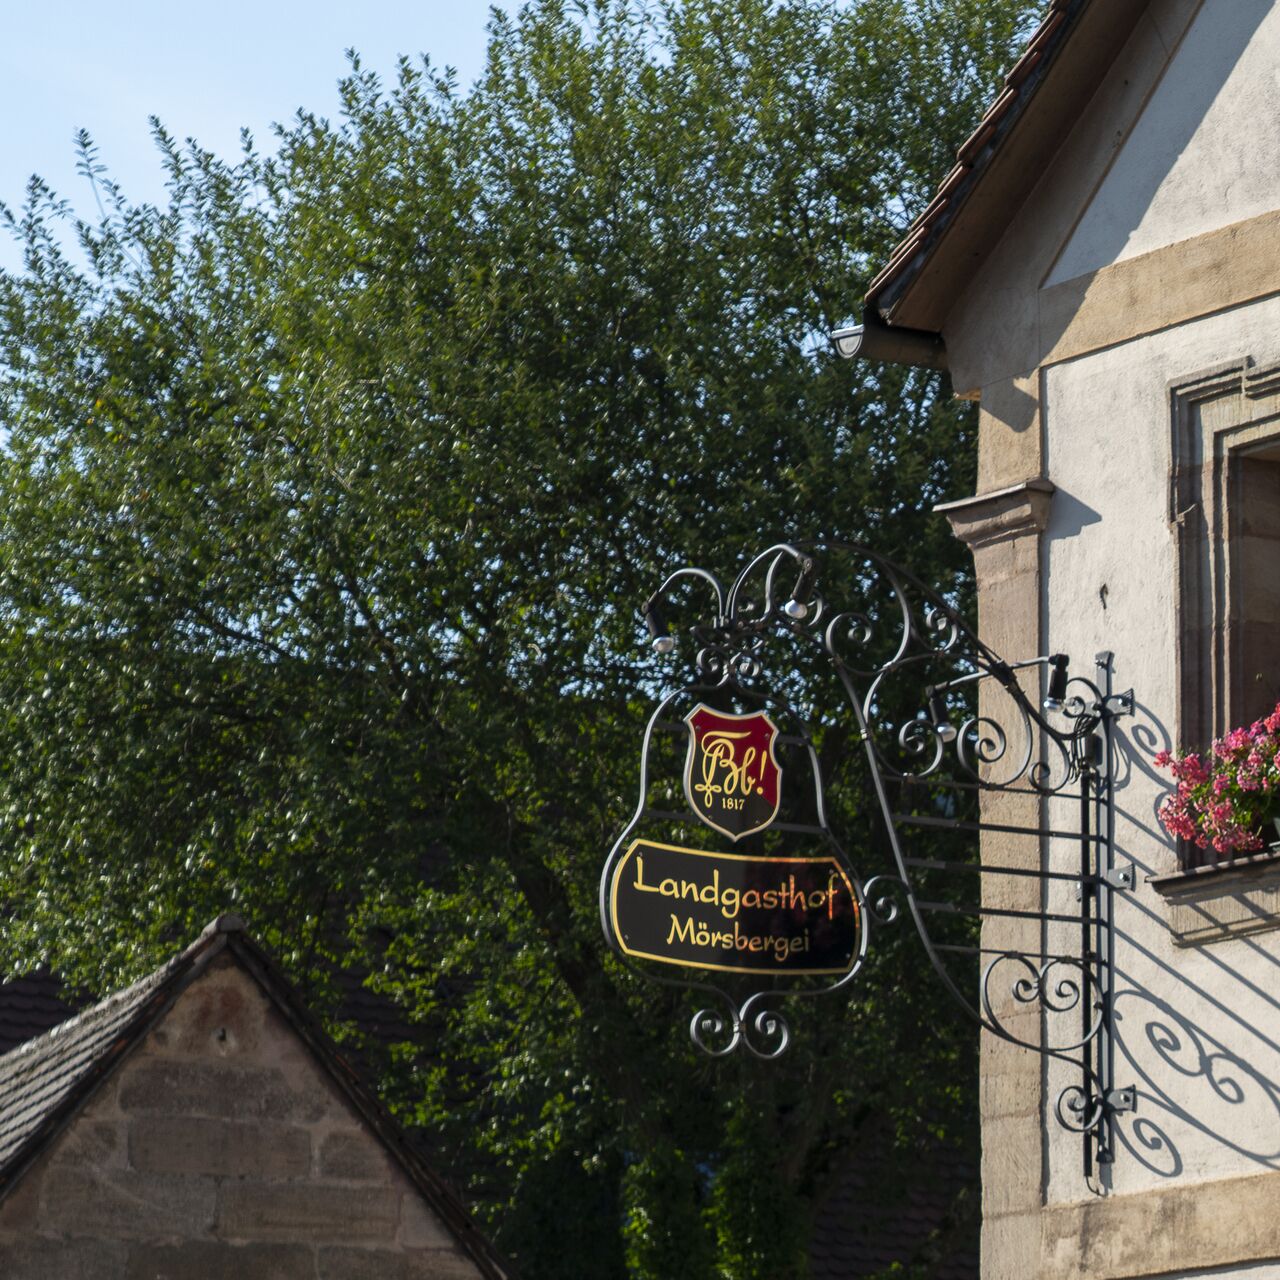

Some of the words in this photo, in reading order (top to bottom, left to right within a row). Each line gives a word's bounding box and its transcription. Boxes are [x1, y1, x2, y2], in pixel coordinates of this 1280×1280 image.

[721, 796, 746, 811] 1817
[633, 855, 840, 920] Landgasthof
[666, 913, 810, 962] Mörsbergei
